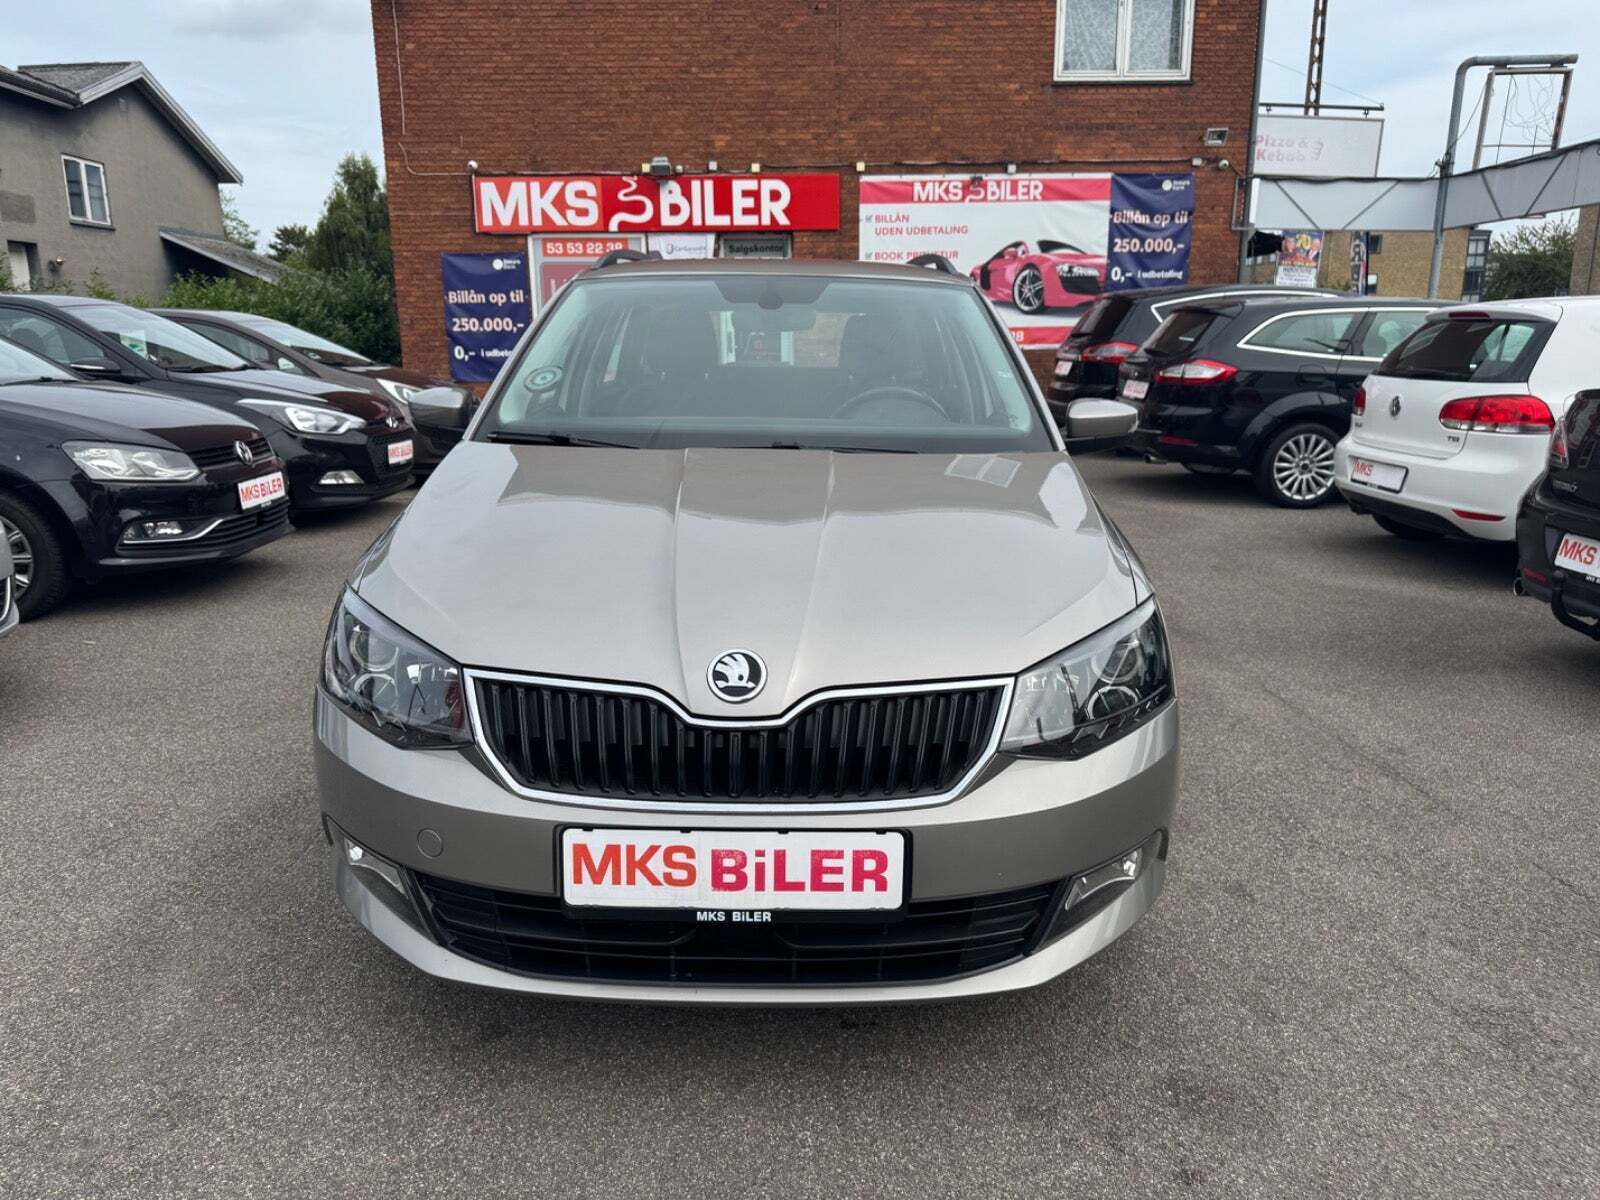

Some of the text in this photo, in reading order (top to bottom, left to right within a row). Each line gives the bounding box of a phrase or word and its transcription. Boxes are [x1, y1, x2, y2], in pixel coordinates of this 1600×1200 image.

[1256, 134, 1295, 147] Pizza
[1256, 148, 1305, 162] Kebab
[913, 180, 1043, 202] MKS BILER
[480, 178, 792, 227] MKS BILER
[874, 213, 910, 224] BILLÅN
[1113, 210, 1188, 227] Billån op til
[874, 225, 969, 236] UDEN UDBETALING
[546, 242, 564, 254] 53
[566, 242, 583, 254] 53
[586, 242, 604, 254] 22
[728, 243, 784, 255] Salgskontor
[1113, 238, 1185, 254] 250.000,-
[874, 251, 903, 260] BOOK
[448, 289, 524, 306] Billån op til
[452, 318, 524, 333] 250.000,-
[1354, 459, 1374, 476] MKS
[241, 484, 260, 501] MKS
[1558, 538, 1598, 565] MKS
[571, 843, 698, 888] MKS
[696, 911, 726, 923] MKS
